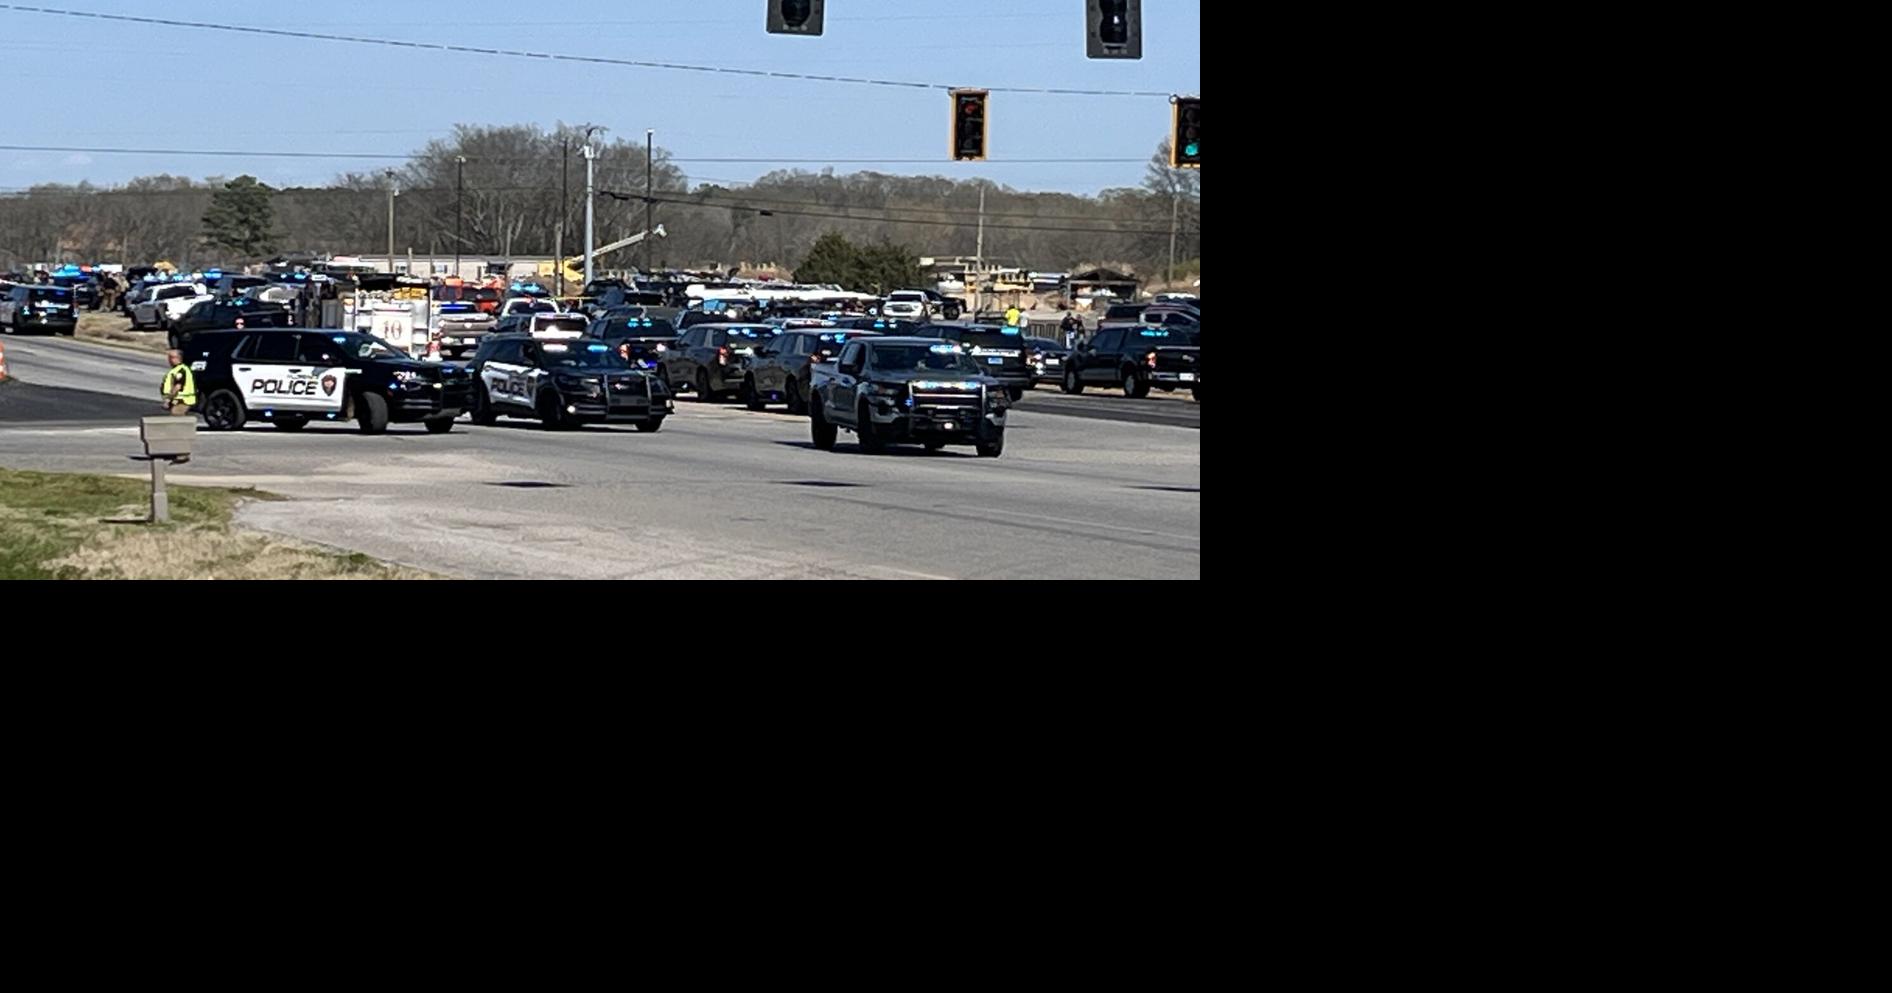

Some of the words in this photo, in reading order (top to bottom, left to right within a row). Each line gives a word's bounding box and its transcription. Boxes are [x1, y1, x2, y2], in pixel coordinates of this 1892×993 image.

[383, 320, 402, 340] 10
[251, 379, 318, 395] POLICE
[491, 378, 525, 396] POLICE
